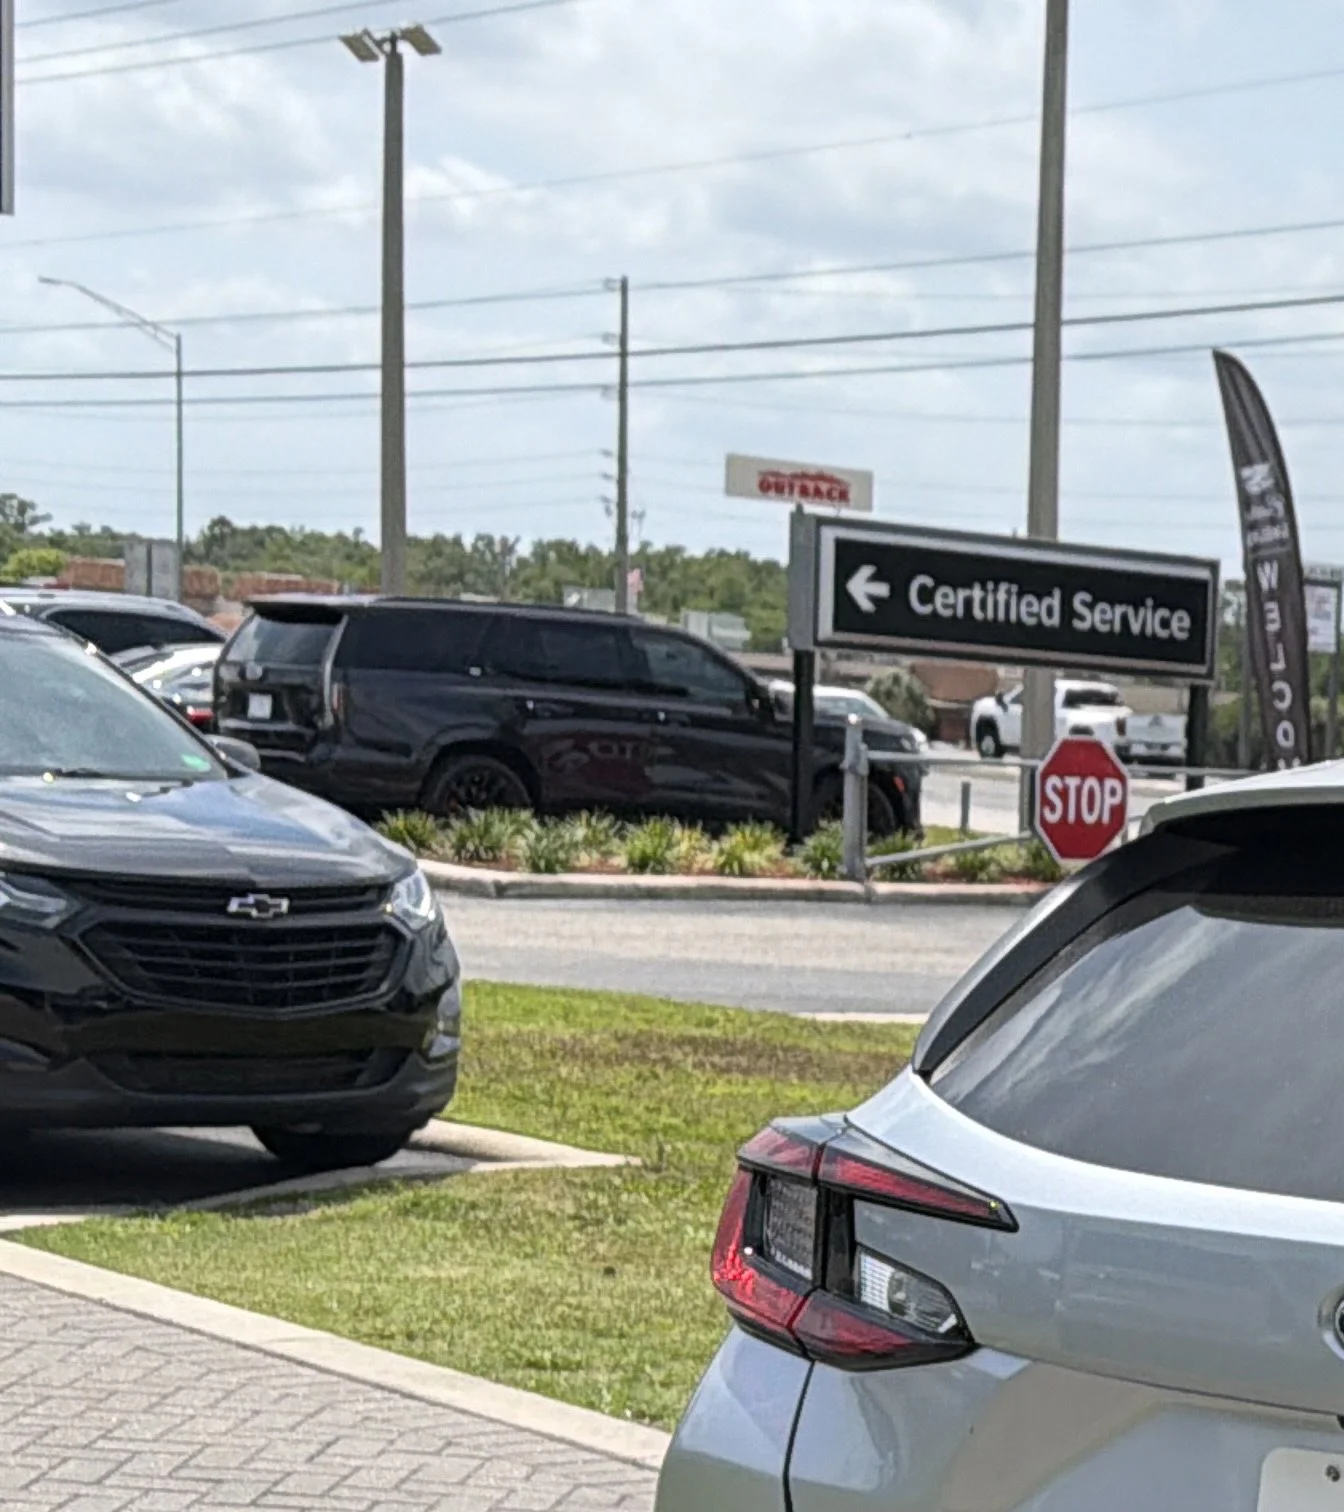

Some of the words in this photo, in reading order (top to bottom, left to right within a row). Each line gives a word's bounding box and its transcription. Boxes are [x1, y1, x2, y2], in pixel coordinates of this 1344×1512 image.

[909, 574, 1061, 628] Certified
[1072, 592, 1191, 640] Service
[1043, 774, 1122, 824] STOP
